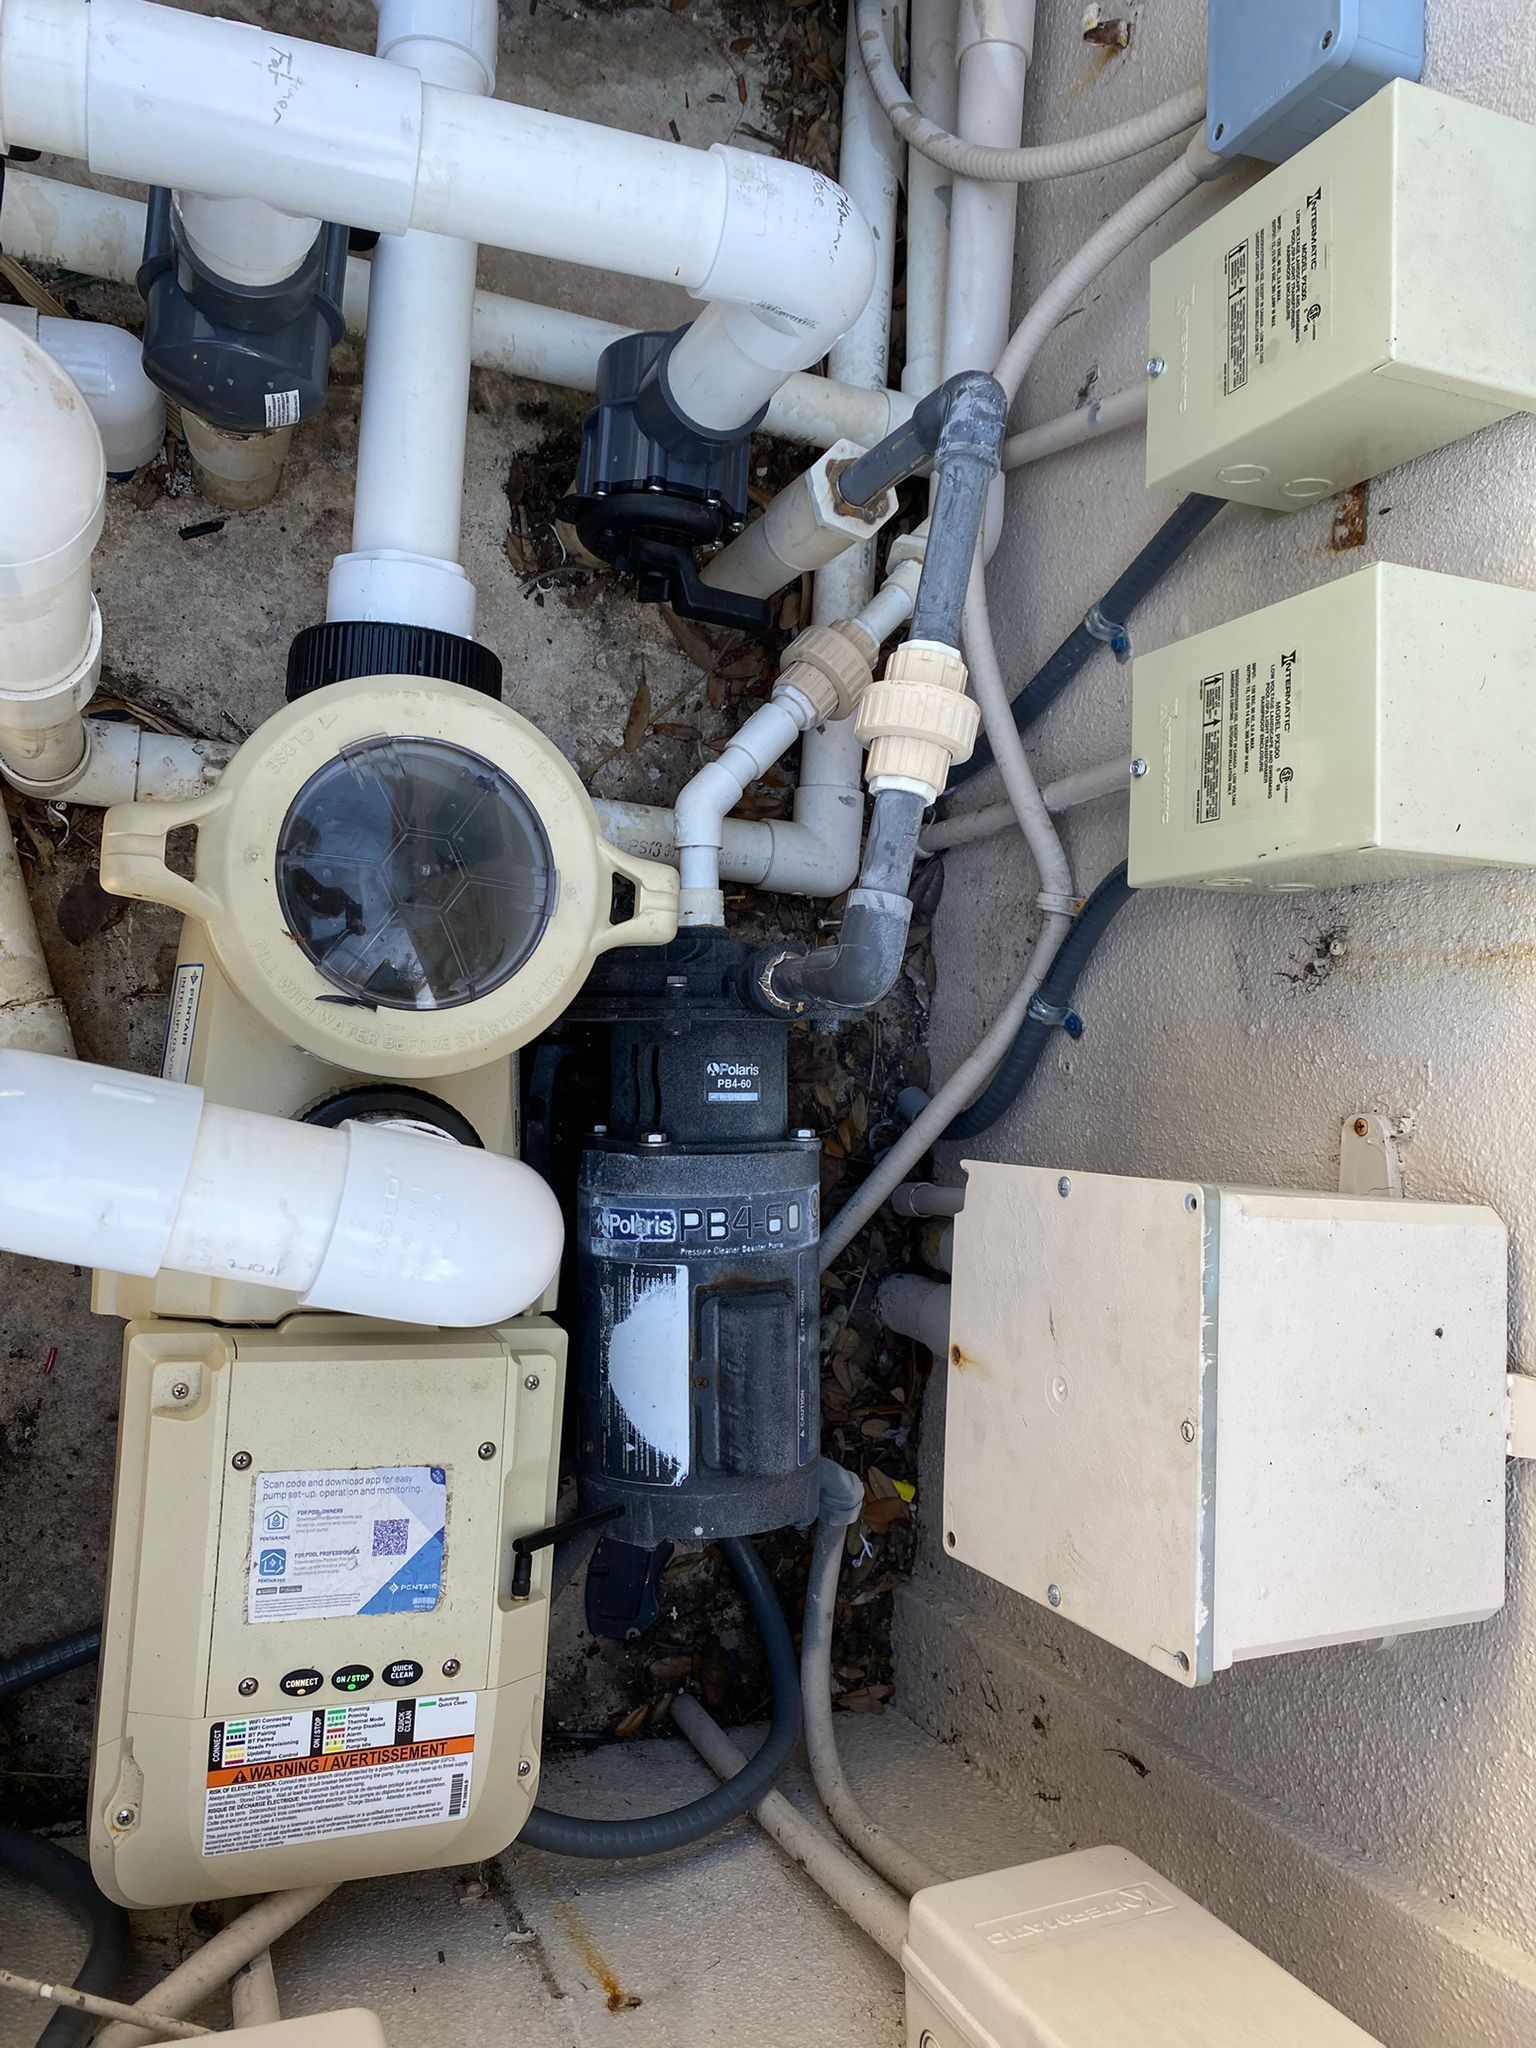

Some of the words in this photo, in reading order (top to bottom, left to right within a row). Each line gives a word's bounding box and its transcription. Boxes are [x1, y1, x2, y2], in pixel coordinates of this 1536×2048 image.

[1306, 185, 1321, 272] INTERMATIC
[1279, 649, 1296, 733] INTERMATIC
[251, 939, 279, 978] FILL
[280, 976, 315, 1013] WITH
[321, 1010, 379, 1047] WATER
[383, 1035, 451, 1054] BEFORE
[456, 1001, 534, 1048] STARTING
[531, 963, 567, 1005] PUMP
[179, 987, 196, 1046] PENTAIR
[720, 1063, 759, 1076] Polaris
[717, 1079, 751, 1089] PB4-60
[679, 1200, 801, 1242] PB4-60
[263, 1480, 284, 1489] Scan
[285, 1479, 306, 1488] code
[307, 1478, 322, 1487] and
[324, 1476, 364, 1486] download
[364, 1477, 380, 1487] app
[381, 1475, 393, 1483] for
[393, 1475, 413, 1484] easy
[262, 1490, 287, 1501] pump
[288, 1488, 318, 1500] set-up,
[319, 1486, 358, 1499] operation
[359, 1486, 377, 1495] and
[378, 1484, 422, 1495] monitoring.
[400, 1583, 439, 1591] PENTAIR
[392, 1664, 413, 1672] QUICK
[351, 1673, 370, 1682] STOP
[391, 1671, 414, 1679] CLEAN
[285, 1677, 319, 1688] CONNECT
[438, 1695, 459, 1703] Running
[348, 1705, 369, 1713] Running
[261, 1714, 292, 1724] Connecting
[347, 1711, 367, 1719] Priming
[404, 1709, 412, 1732] CLEAN
[261, 1721, 290, 1729] Connected
[313, 1716, 321, 1733] STOP
[346, 1724, 362, 1732] Pump
[362, 1721, 385, 1729] Disabled
[397, 1710, 405, 1732] QUICK
[257, 1729, 276, 1737] Pairing
[212, 1728, 221, 1762] CONNECT
[265, 1738, 299, 1749] Provisioning
[312, 1739, 320, 1748] ON
[346, 1736, 367, 1744] Warning
[246, 1748, 271, 1757] Updating
[245, 1754, 277, 1763] Automation
[249, 1758, 319, 1781] WARNING
[330, 1740, 447, 1769] AVERTISSEMENT
[230, 1783, 256, 1792] ELECTRIC
[257, 1780, 276, 1788] SHOCK:
